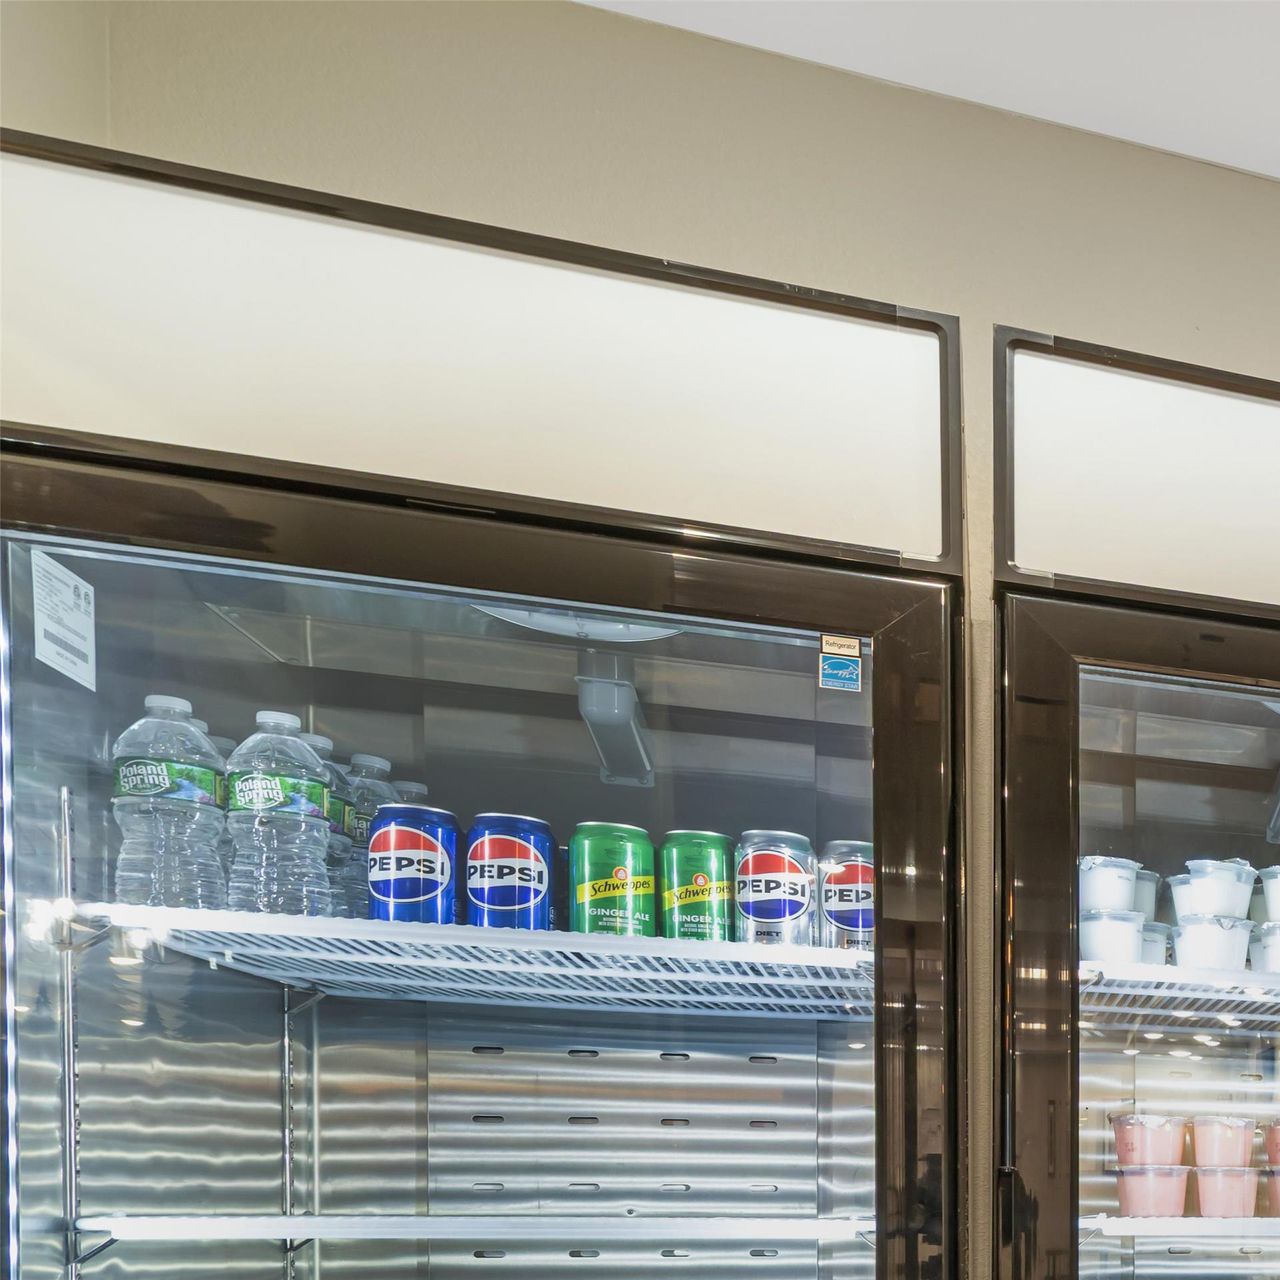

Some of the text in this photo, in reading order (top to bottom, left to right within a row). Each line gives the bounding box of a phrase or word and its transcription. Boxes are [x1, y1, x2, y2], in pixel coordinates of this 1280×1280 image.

[119, 763, 167, 778] Poland
[120, 774, 171, 792] Spring
[369, 857, 444, 876] PEPSI
[468, 865, 543, 884] PEPSI
[591, 879, 650, 897] Schweppes
[738, 880, 805, 897] PEPSI
[825, 889, 874, 903] PEP
[634, 911, 649, 921] ALE
